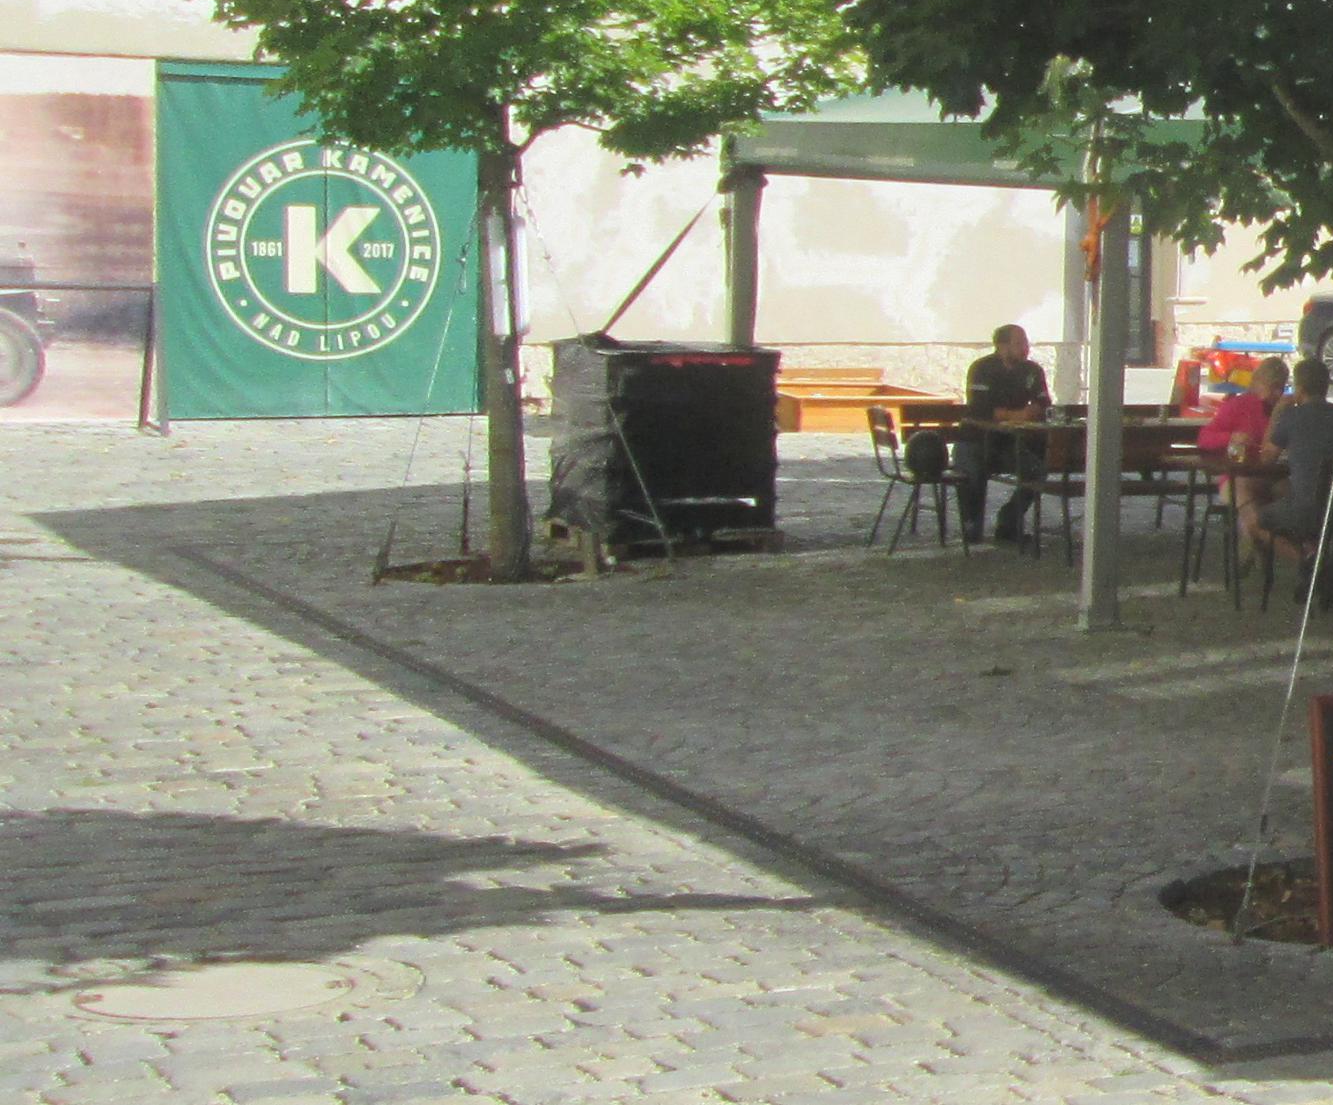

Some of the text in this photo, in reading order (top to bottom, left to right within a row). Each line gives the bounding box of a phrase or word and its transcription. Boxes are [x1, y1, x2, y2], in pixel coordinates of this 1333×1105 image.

[216, 148, 432, 283] PIVOVAR KAMENICE
[251, 241, 283, 257] 1861
[287, 206, 382, 294] K
[363, 243, 395, 259] 2017
[253, 312, 397, 352] NAD LIPOU
